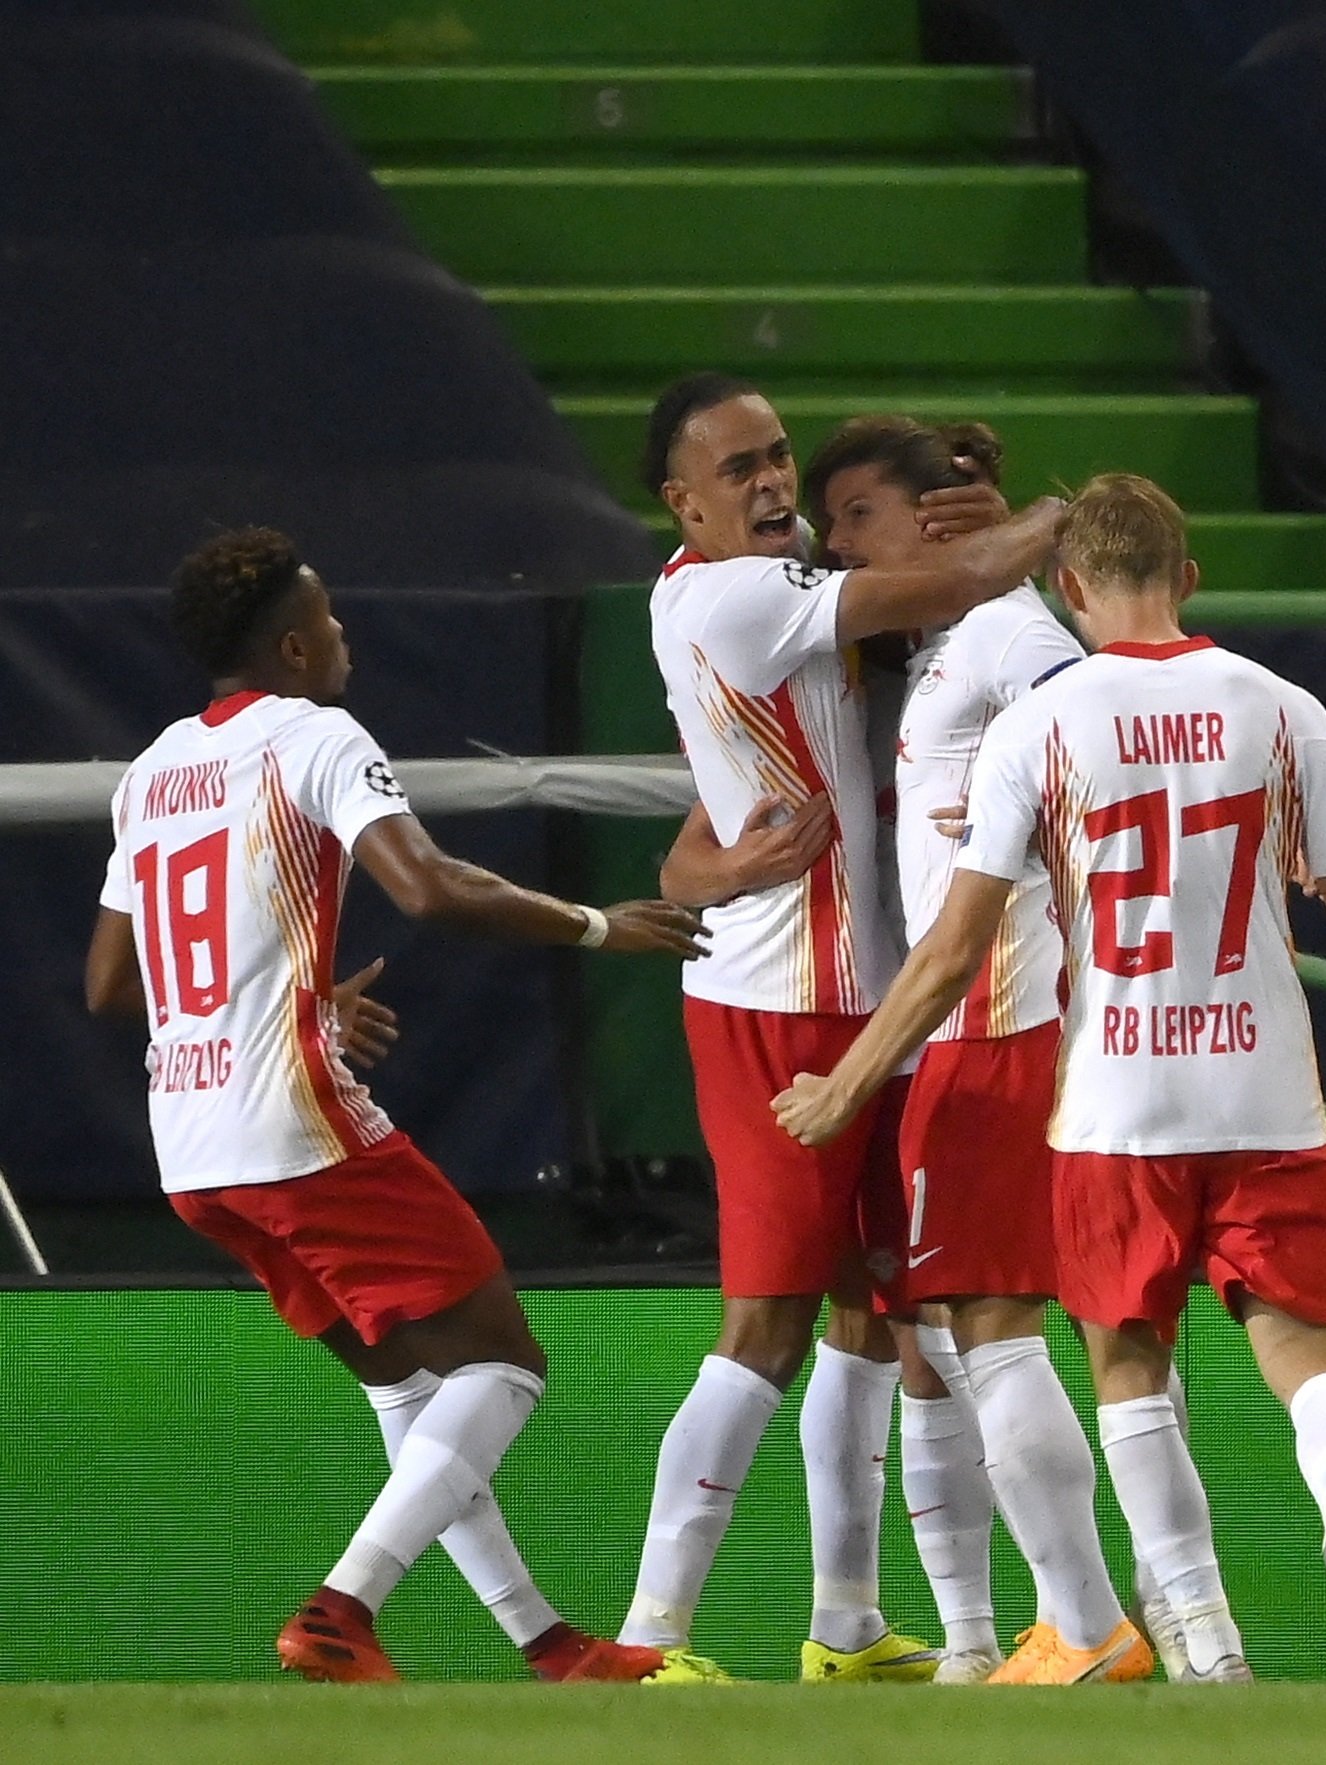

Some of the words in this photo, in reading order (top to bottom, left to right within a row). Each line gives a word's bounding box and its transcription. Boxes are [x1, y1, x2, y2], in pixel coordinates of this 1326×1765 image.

[1114, 712, 1226, 765] LAIMER
[142, 759, 229, 822] NKUNKU
[1084, 787, 1267, 979] 27
[133, 827, 230, 1029] 18
[1103, 1005, 1140, 1056] RB
[1151, 1001, 1258, 1056] LEIPZIG
